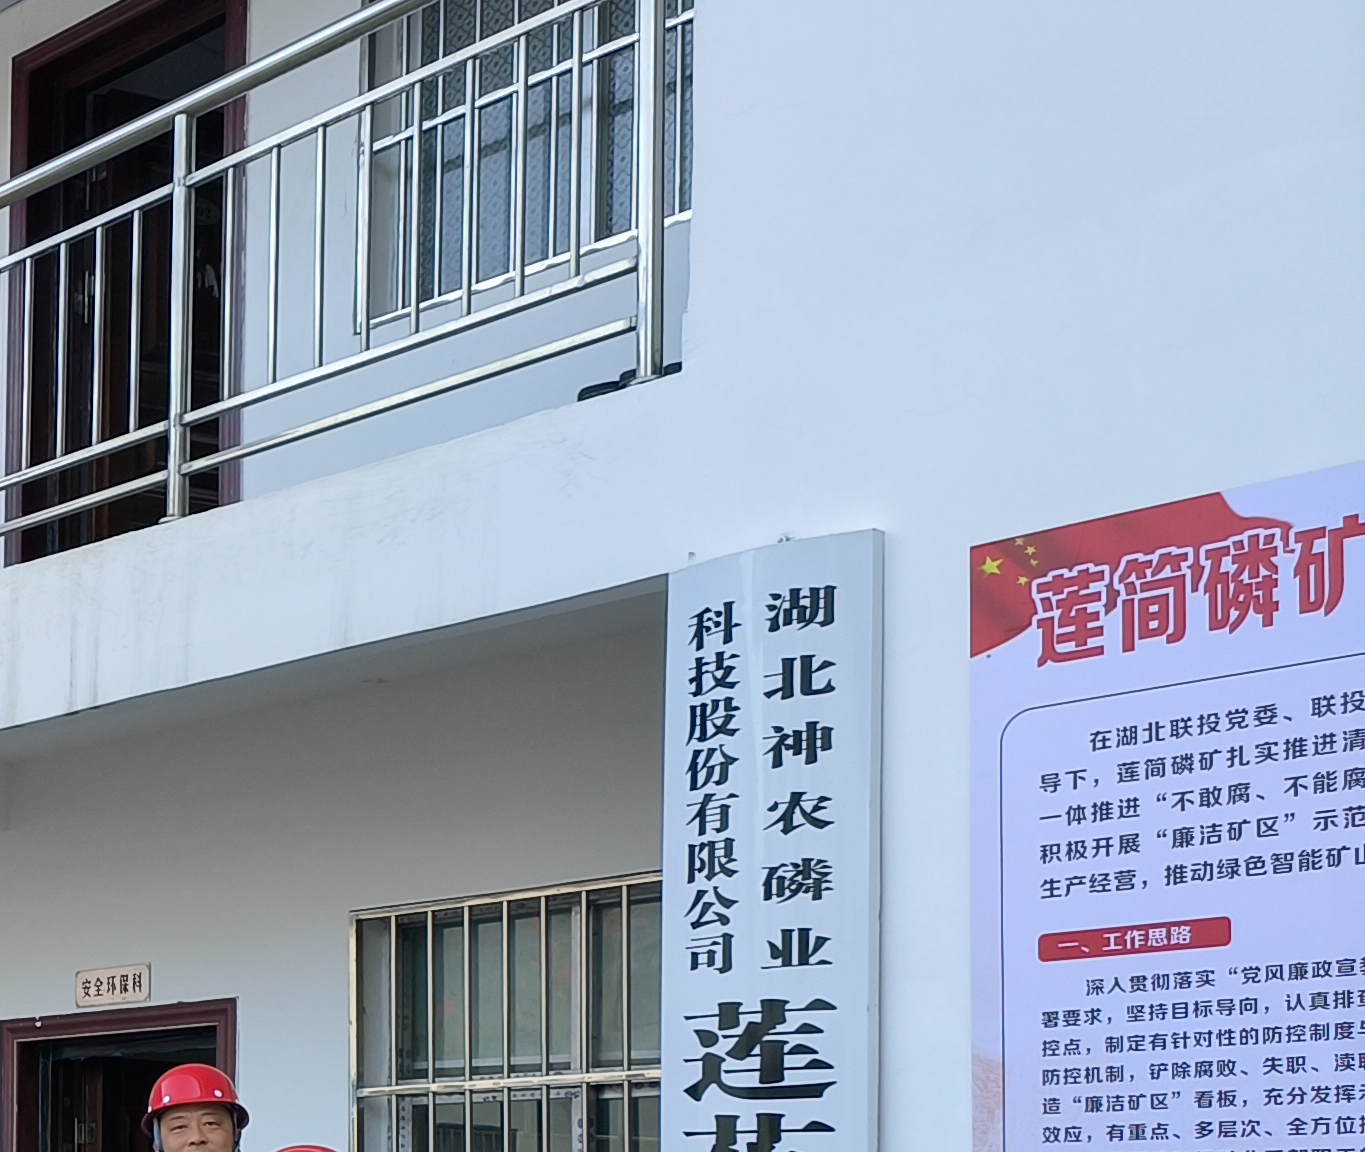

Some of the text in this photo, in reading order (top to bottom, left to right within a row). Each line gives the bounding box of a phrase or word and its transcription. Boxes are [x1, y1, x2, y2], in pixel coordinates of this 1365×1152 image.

[1036, 514, 1365, 667] 莲简磷矿
[684, 600, 742, 975] 科技股份有限公司
[760, 584, 837, 970] 湖北神农磷业
[1058, 925, 1192, 953] 一、工作思路
[81, 971, 143, 999] 安全环保科
[1041, 1115, 1365, 1144] 效应，有重点、多层次、全方位
